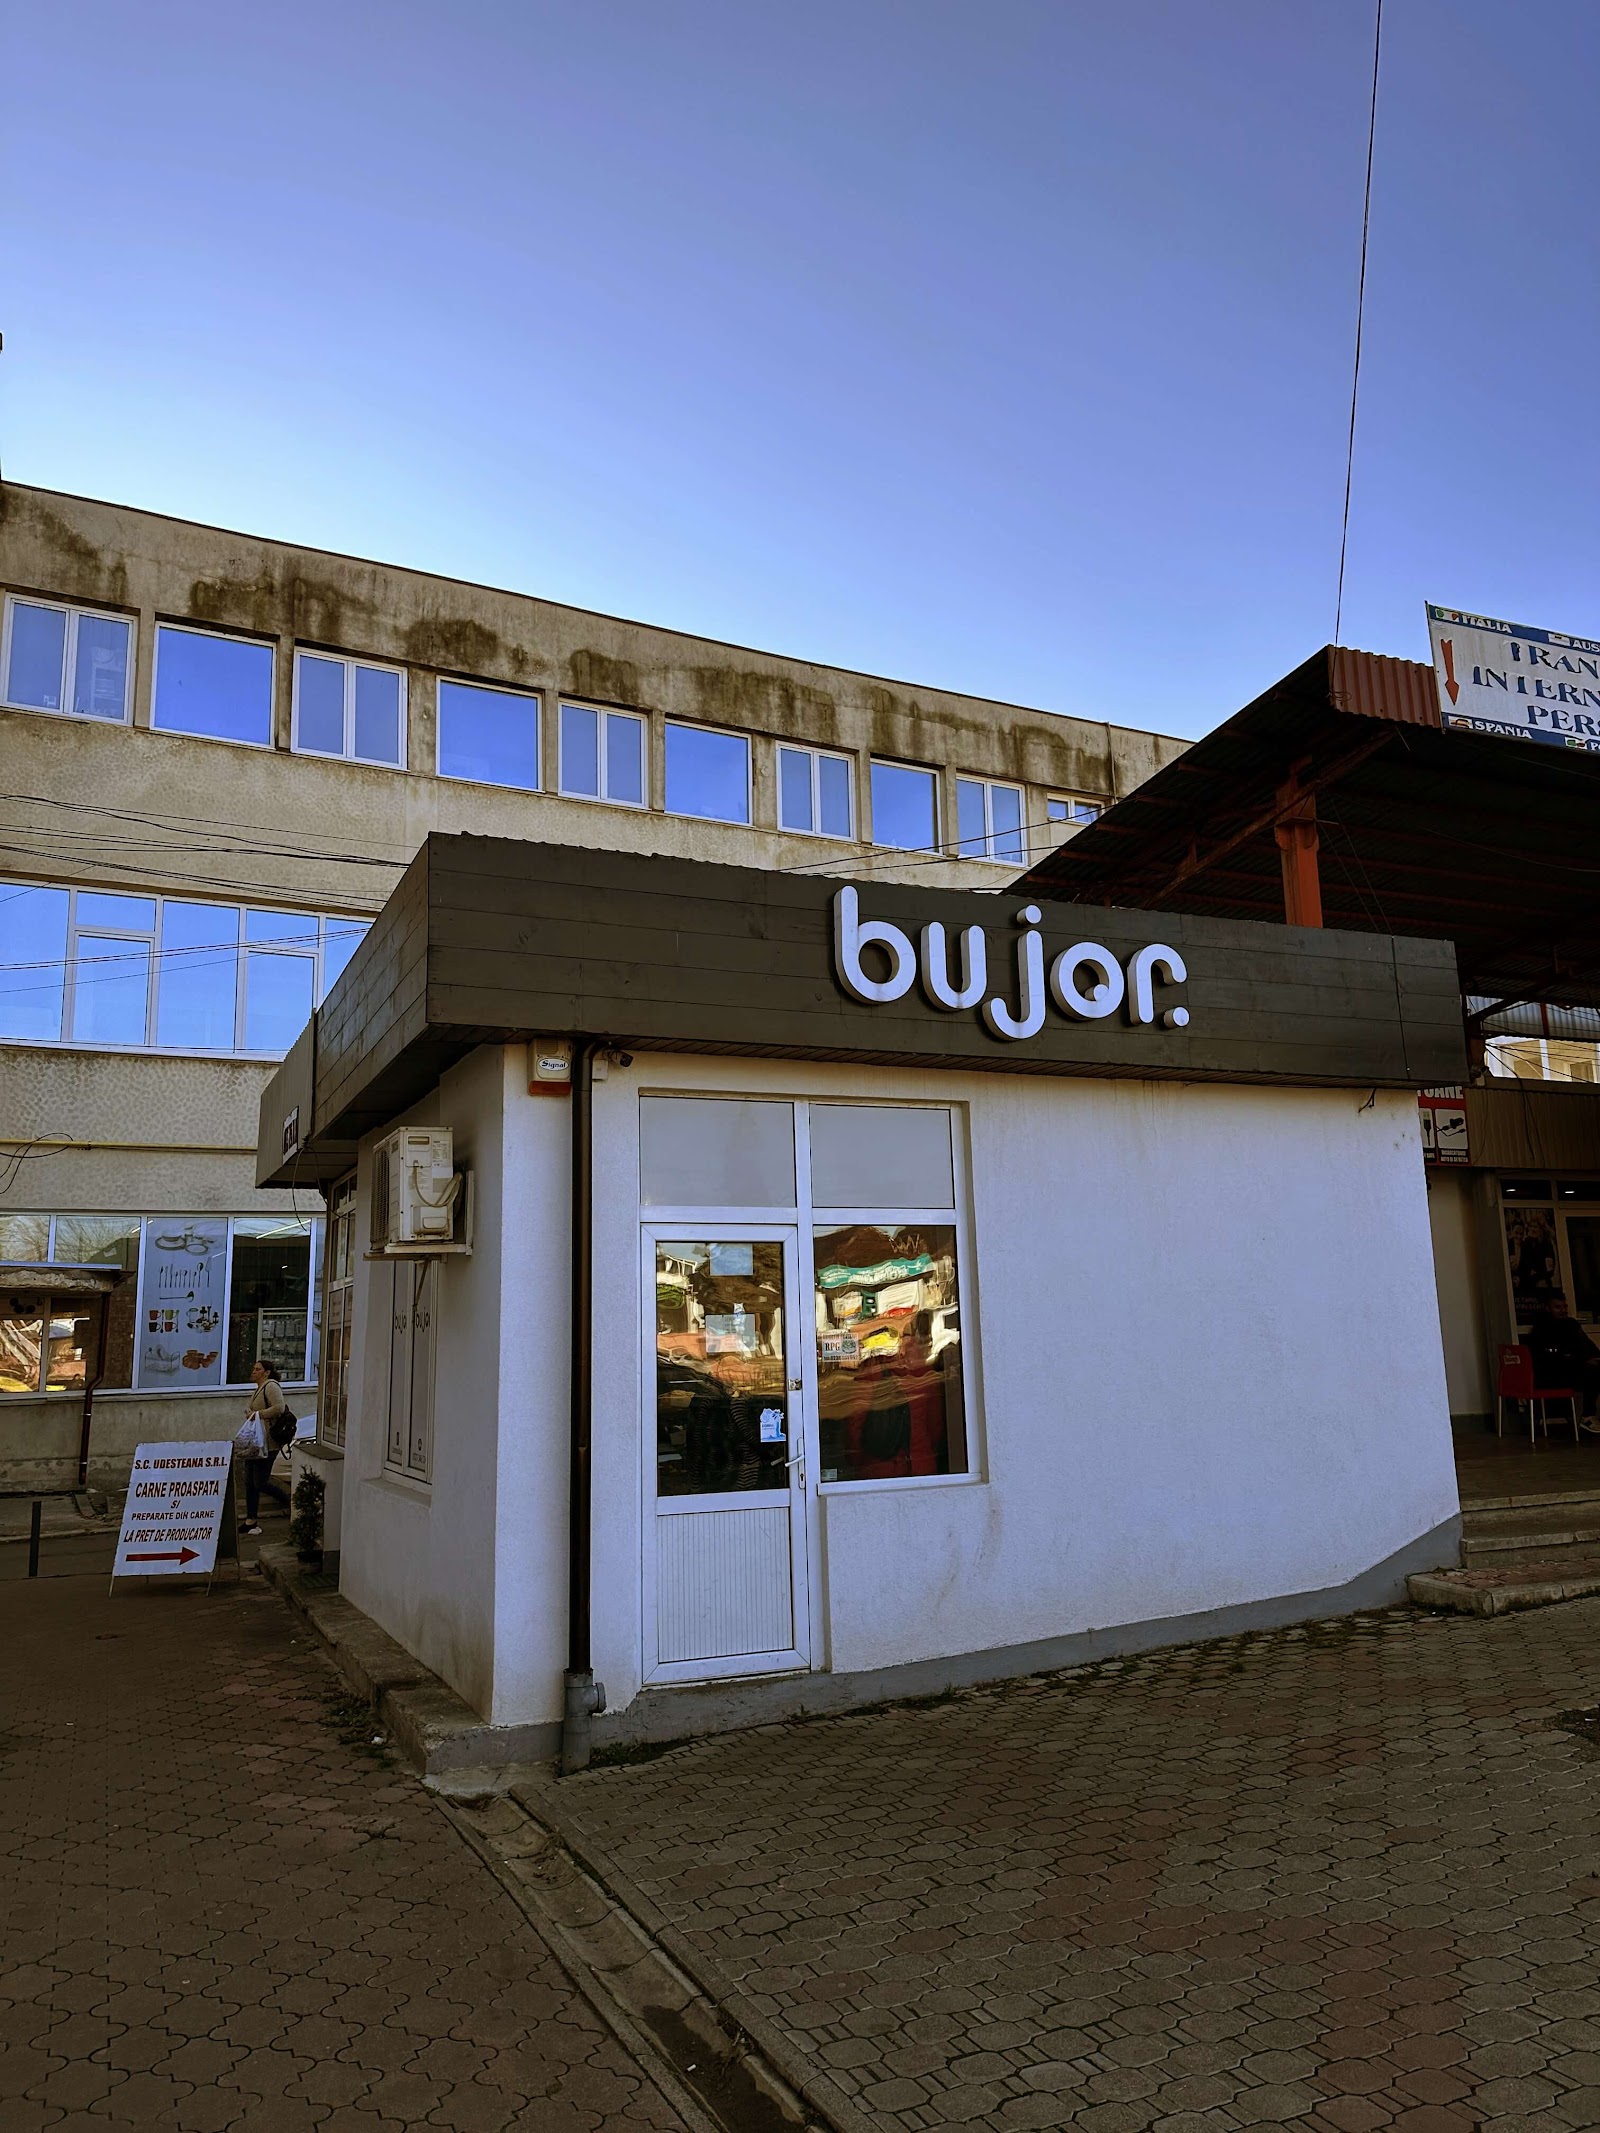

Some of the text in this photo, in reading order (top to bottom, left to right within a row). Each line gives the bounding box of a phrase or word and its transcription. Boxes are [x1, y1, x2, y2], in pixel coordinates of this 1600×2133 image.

[1461, 614, 1513, 634] ITALIA
[1504, 640, 1599, 679] TRAN
[1527, 704, 1600, 736] PER
[1474, 720, 1533, 739] SPANIA
[542, 1060, 566, 1068] Signal
[134, 1456, 228, 1469] S.C. UDESTEANA S.R.L.
[135, 1480, 219, 1498] CARNE PROASPATA
[131, 1510, 215, 1521] PREPARATE DIN CARNE
[123, 1526, 213, 1543] LA PRET DE PRODUCATOR
